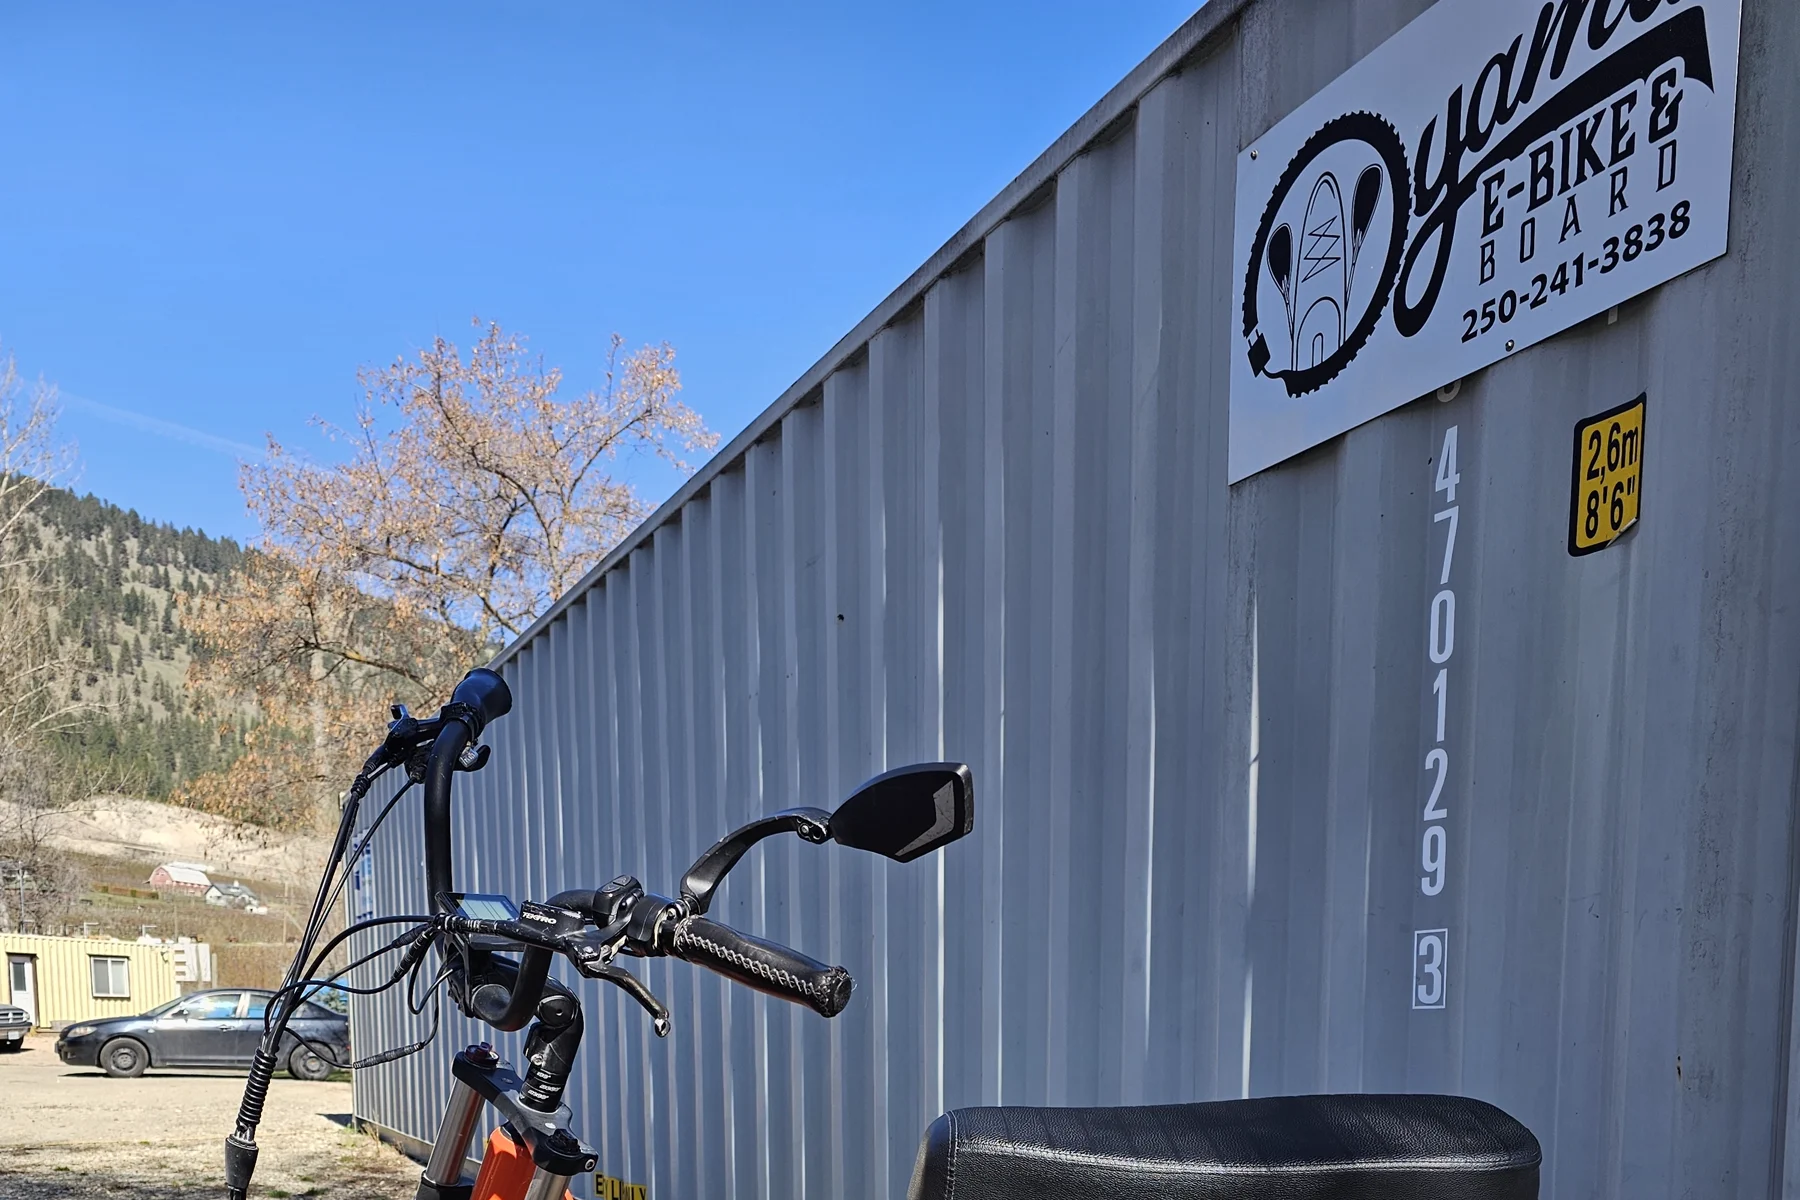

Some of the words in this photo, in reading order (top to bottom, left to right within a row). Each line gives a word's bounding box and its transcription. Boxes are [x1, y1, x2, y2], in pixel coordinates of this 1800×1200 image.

[1480, 89, 1638, 239] E-BIKE
[1648, 67, 1684, 144] &
[1478, 138, 1677, 286] BOARD
[1461, 199, 1691, 344] 250-241-3838
[1585, 474, 1636, 539] 8'6"
[1586, 421, 1639, 485] 2,6m
[1416, 934, 1444, 1005] 3
